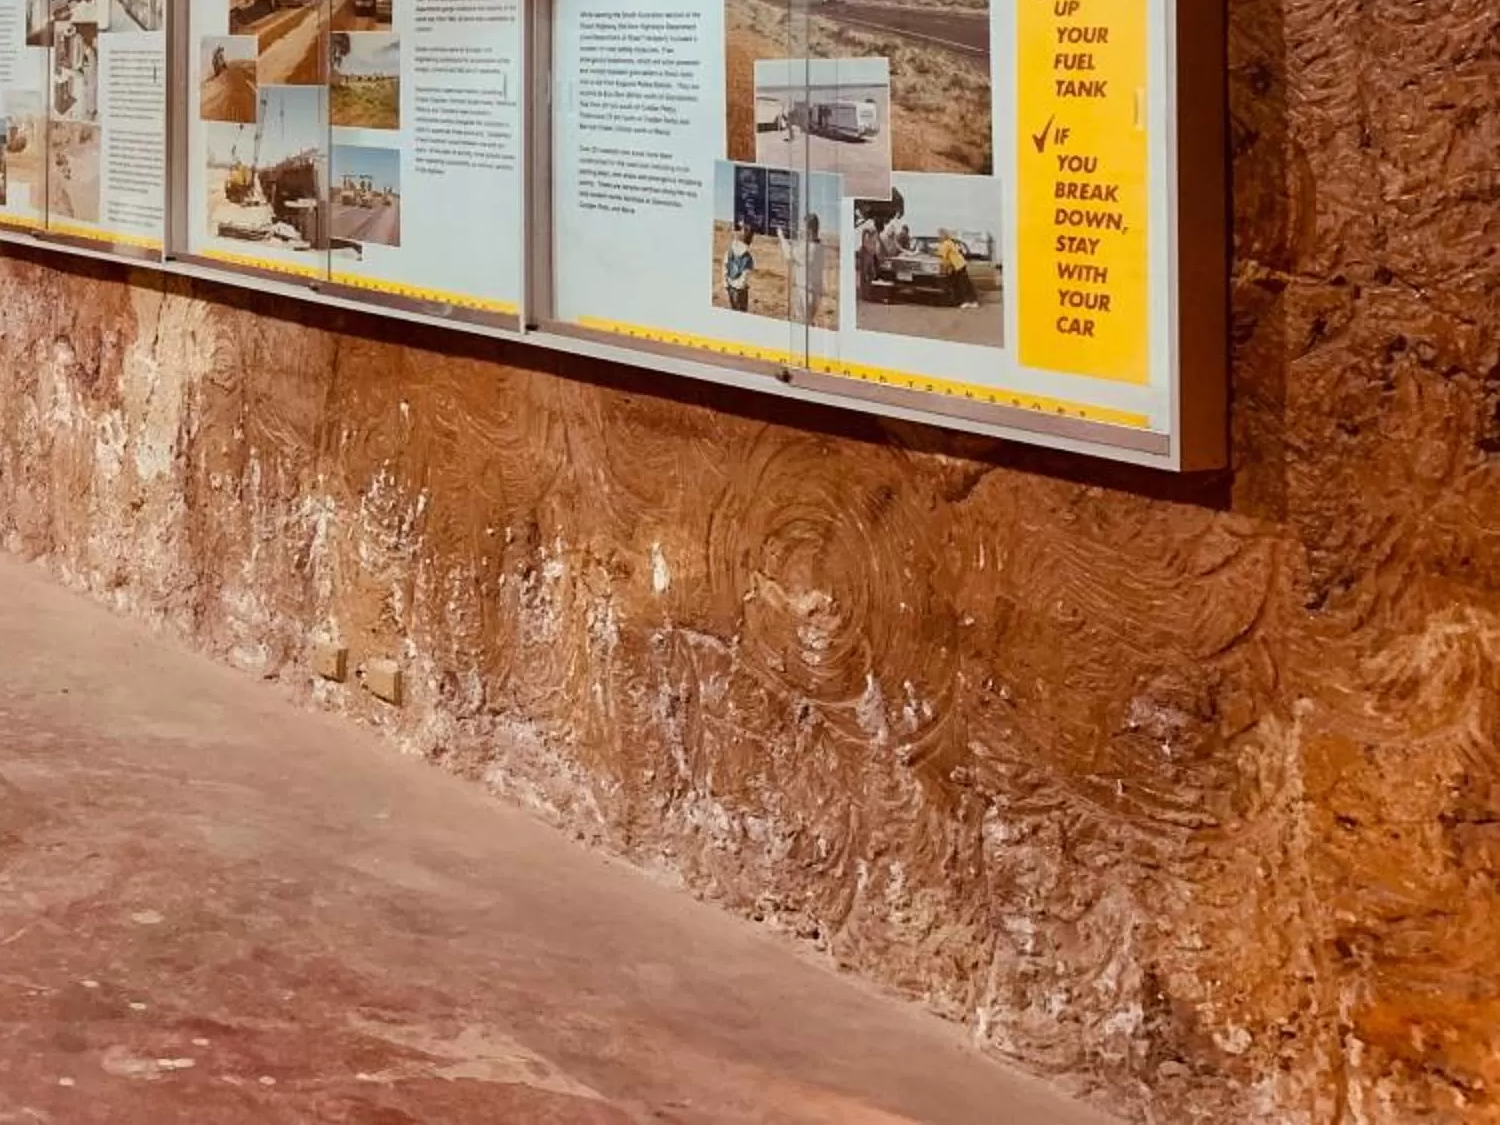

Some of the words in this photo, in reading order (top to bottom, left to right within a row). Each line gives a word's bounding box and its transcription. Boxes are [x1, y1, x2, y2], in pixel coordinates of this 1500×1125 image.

[1054, 0, 1080, 17] UP
[1057, 26, 1109, 44] YOUR
[1054, 53, 1096, 71] FUEL
[1055, 80, 1107, 98] TANK
[1054, 127, 1070, 145] IF
[1057, 154, 1097, 174] YOU
[1055, 182, 1119, 203] BREAK
[1054, 208, 1128, 235] DOWN,
[1056, 235, 1100, 256] STAY
[1057, 262, 1108, 284] WITH
[1057, 289, 1111, 312] YOUR
[1056, 316, 1096, 336] CAR
